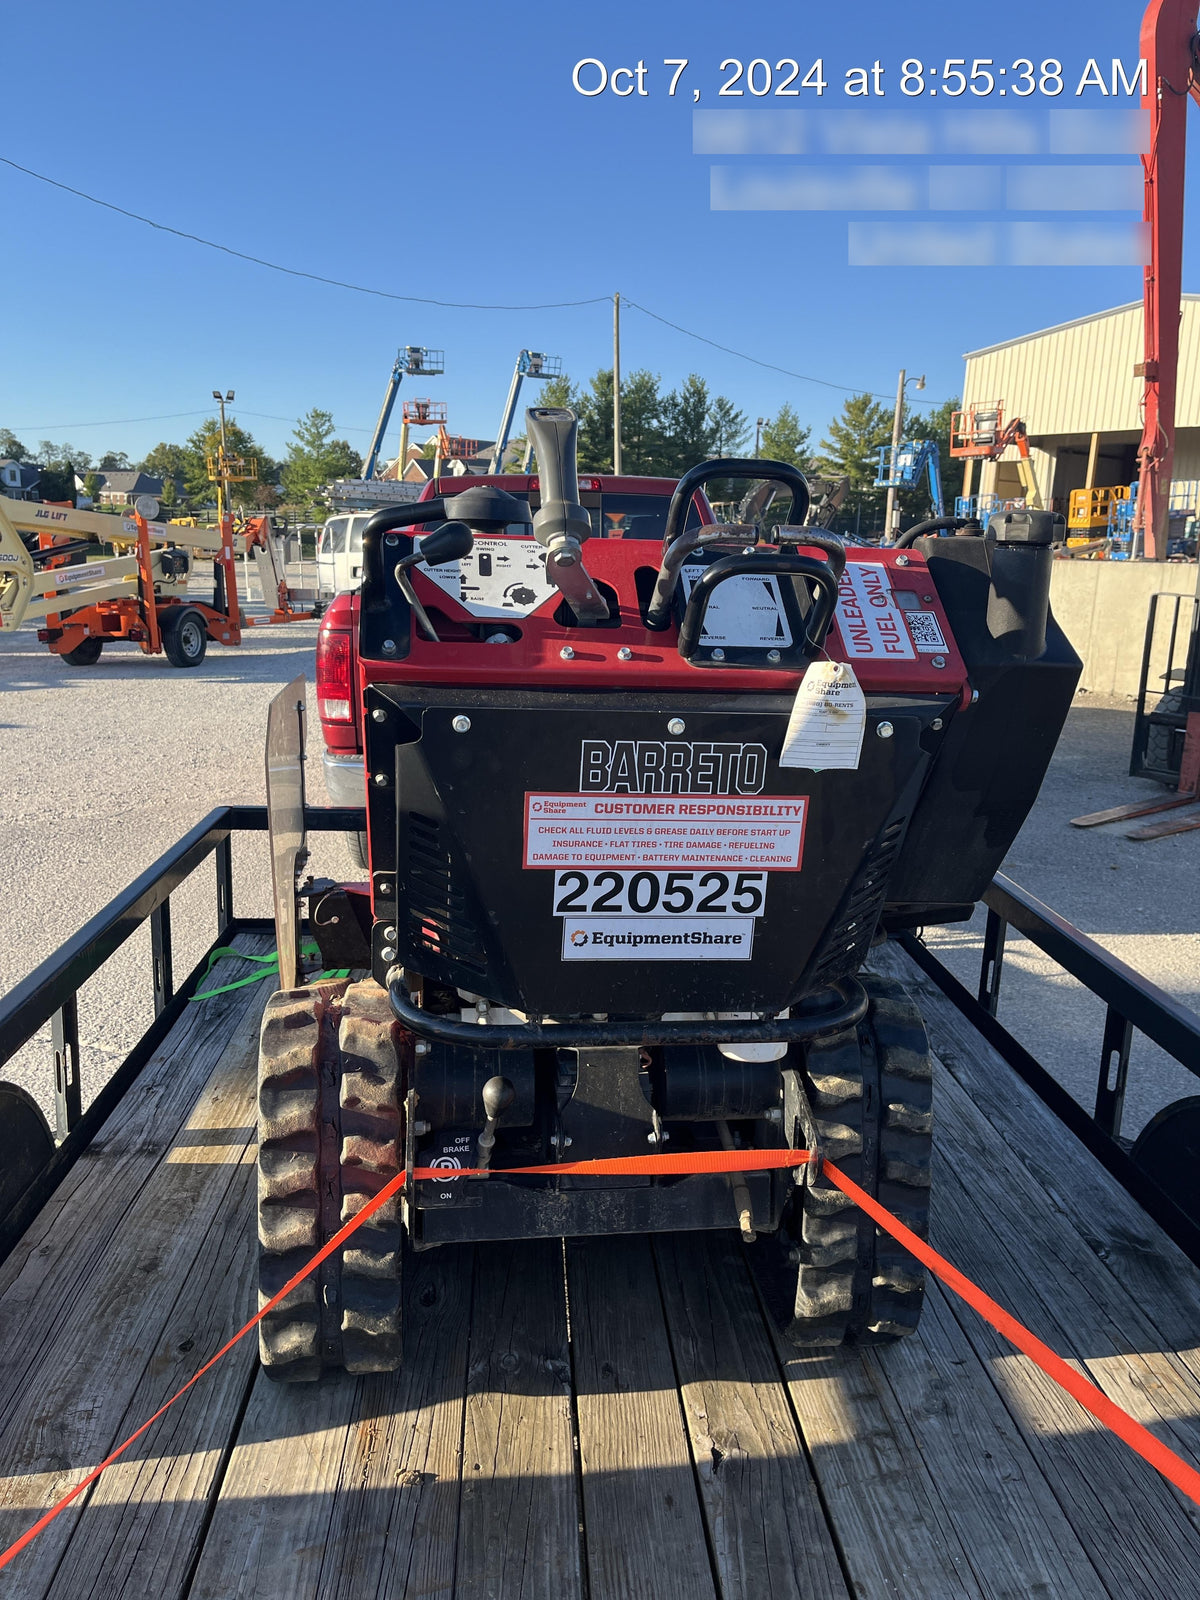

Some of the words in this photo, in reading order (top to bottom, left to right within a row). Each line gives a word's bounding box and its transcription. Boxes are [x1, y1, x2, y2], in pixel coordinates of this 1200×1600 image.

[35, 510, 49, 519] JLG
[51, 511, 68, 521] LIFT
[859, 567, 888, 608] ONLY
[875, 612, 905, 654] FUEL
[815, 688, 840, 696] Share
[579, 740, 768, 795] BARRETO
[594, 803, 675, 814] CUSTOMER
[678, 804, 801, 816] RESPONSIBILITY
[586, 827, 612, 835] FLUID
[552, 840, 603, 848] INSURANCE
[664, 841, 683, 849] TIRE
[532, 853, 569, 861] DAMAGE
[584, 854, 636, 862] EQUIPMENT
[749, 855, 792, 863] CLEANING
[556, 871, 763, 914] 220525
[592, 931, 742, 947] EquipmentShare
[443, 1145, 470, 1153] BRAKE
[440, 1192, 452, 1200] ON
